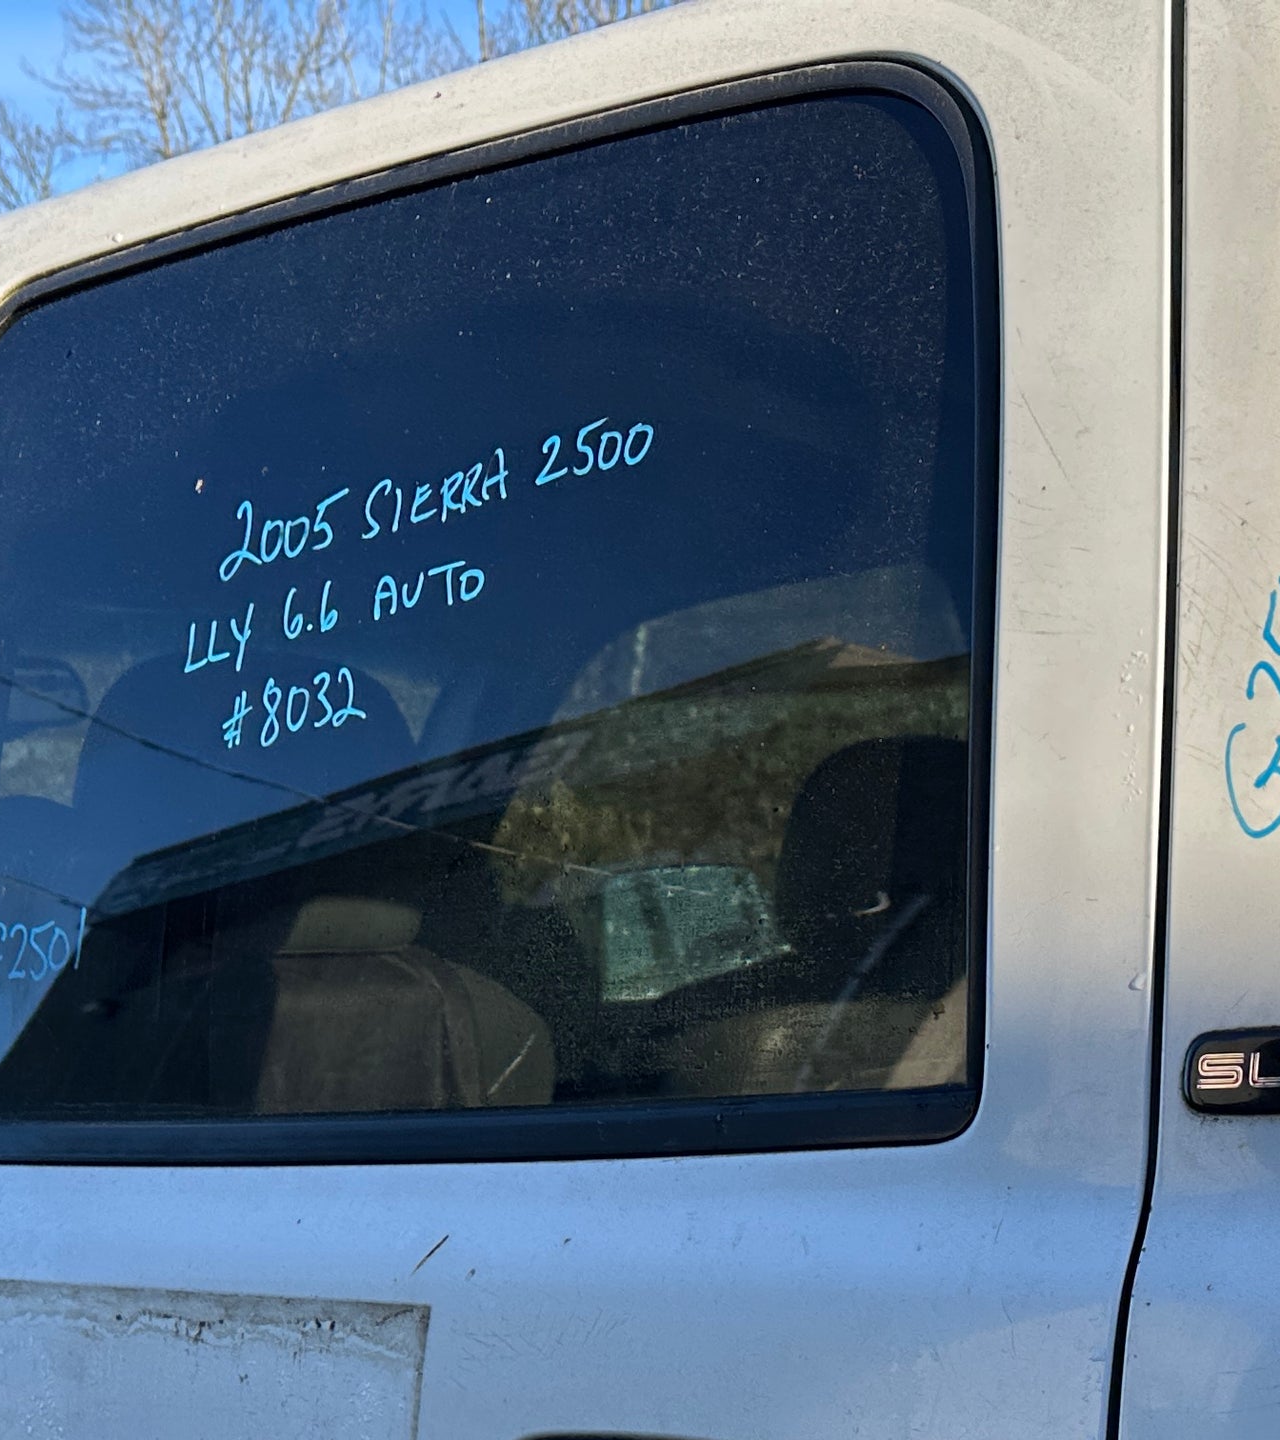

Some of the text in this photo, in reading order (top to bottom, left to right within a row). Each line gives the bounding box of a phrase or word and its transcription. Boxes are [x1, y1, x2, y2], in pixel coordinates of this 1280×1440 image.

[220, 416, 655, 582] 2005 SIERRA 2500
[183, 559, 486, 674] LLY 6.6 AUTO
[221, 665, 367, 749] #8032
